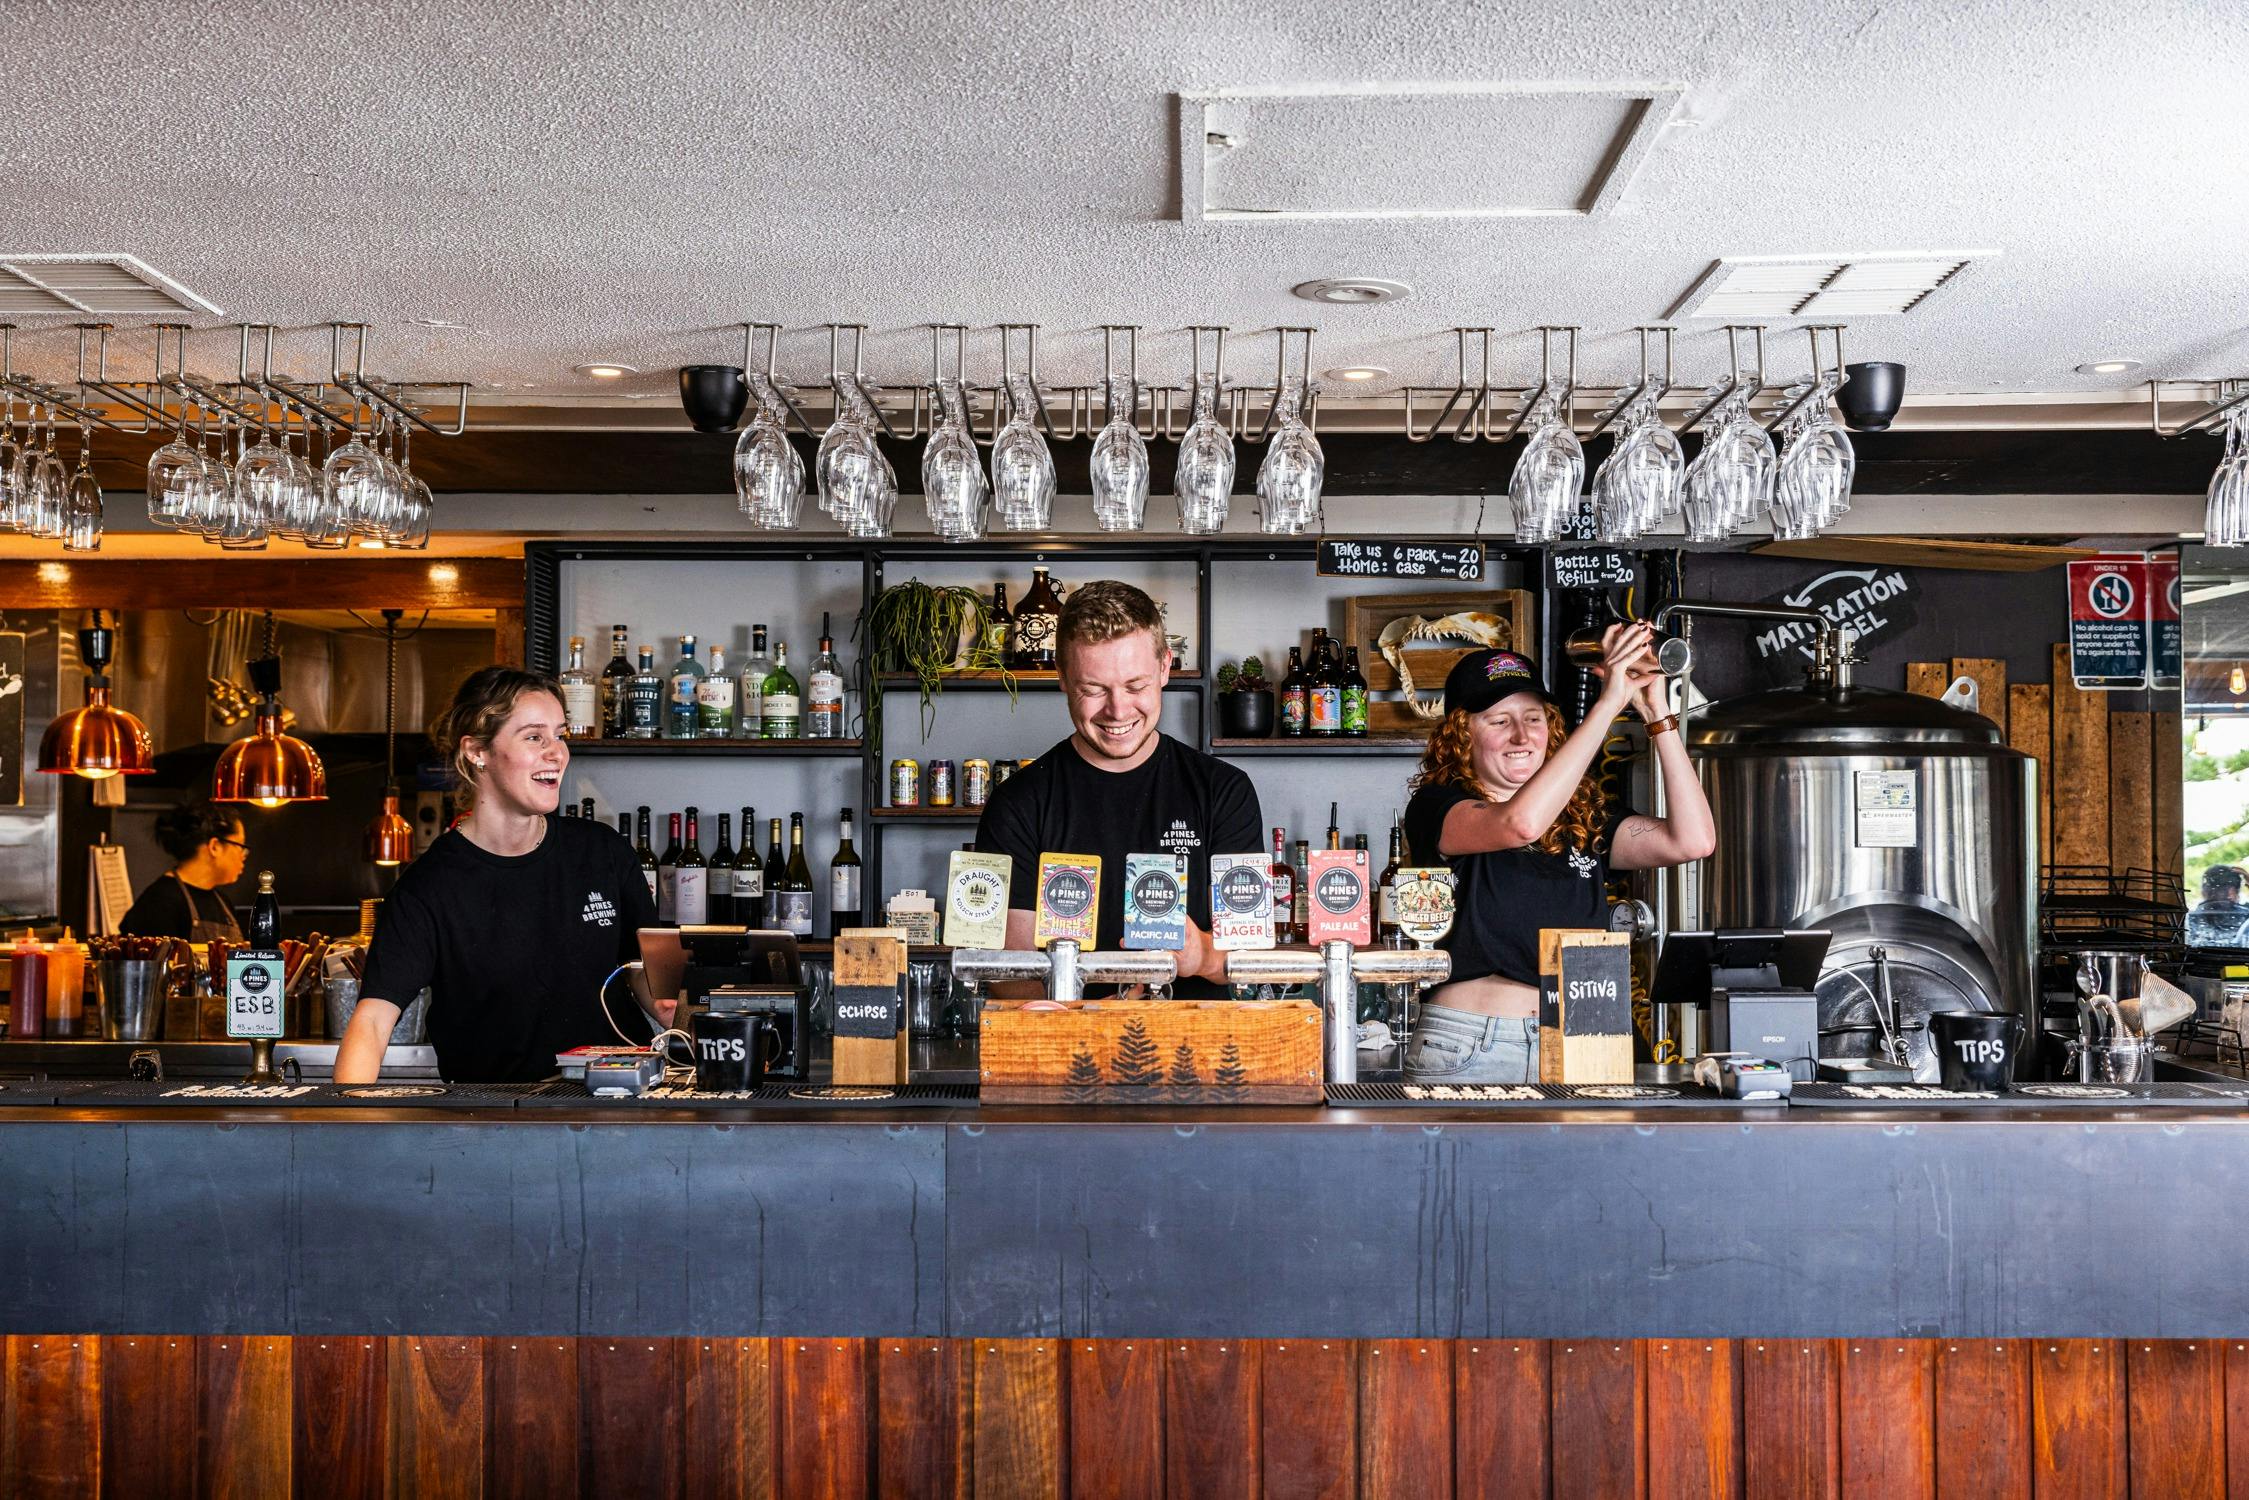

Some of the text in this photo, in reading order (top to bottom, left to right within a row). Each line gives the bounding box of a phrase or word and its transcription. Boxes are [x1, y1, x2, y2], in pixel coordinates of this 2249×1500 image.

[1366, 545, 1382, 558] us
[1393, 546, 1403, 560] 6
[1458, 548, 1479, 564] 20
[1606, 554, 1622, 569] 15
[1396, 562, 1426, 574] case
[1458, 564, 1478, 580] 60
[1614, 568, 1634, 584] 20
[2076, 624, 2086, 632] No
[2088, 624, 2113, 632] alcohol
[2129, 624, 2139, 632] be
[1798, 611, 1888, 662] VSEL
[2076, 632, 2092, 640] sold
[2102, 632, 2132, 641] supplied
[2104, 640, 2124, 648] under
[2088, 650, 2114, 658] against
[1170, 830, 1196, 838] PINES
[1160, 838, 1201, 846] BREWING
[1174, 846, 1190, 854] CO.
[960, 872, 1000, 888] DRAUGHT
[1430, 874, 1456, 890] UNION
[1050, 888, 1087, 900] 4 PINES
[1224, 884, 1261, 894] 4 PINES
[1320, 886, 1358, 895] 4 PINES
[1137, 890, 1174, 899] 4 PINES
[590, 900, 612, 911] PINES
[582, 908, 616, 922] BREWING
[975, 910, 990, 918] STYLE
[1402, 912, 1448, 922] GINGER BEER
[598, 918, 613, 926] CO.
[1320, 922, 1359, 931] PALE ALE
[1050, 928, 1080, 936] PALE ALE
[1130, 930, 1178, 940] PACIFIC ALE
[1224, 926, 1263, 936] LAGER
